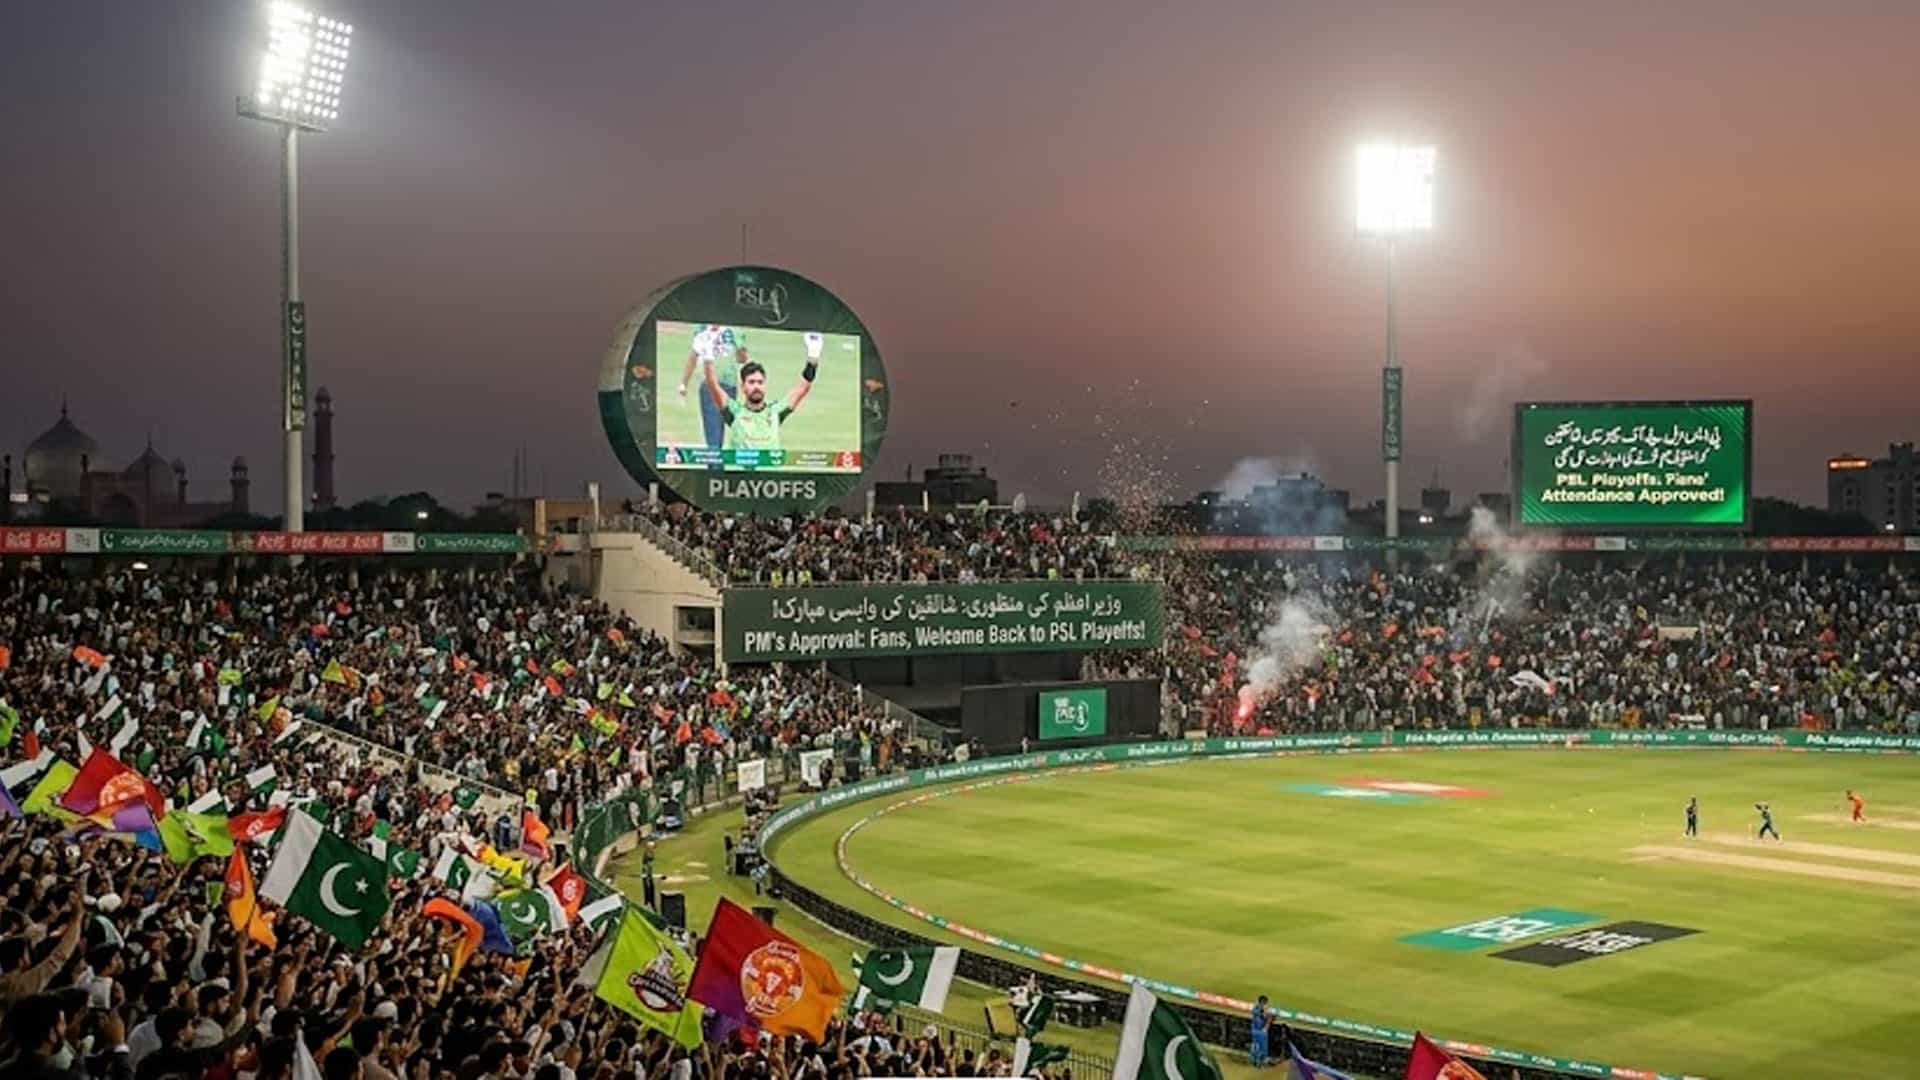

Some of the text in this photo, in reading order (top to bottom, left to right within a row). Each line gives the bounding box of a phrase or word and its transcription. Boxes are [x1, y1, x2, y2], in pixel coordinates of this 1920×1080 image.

[709, 479, 817, 500] PLAYOFFS
[1541, 488, 1725, 504] Attendance Approved!
[744, 631, 785, 653] PM's
[870, 628, 912, 651] Fans,
[989, 624, 1028, 644] Back
[1029, 625, 1046, 643] to
[1049, 622, 1077, 642] PSL
